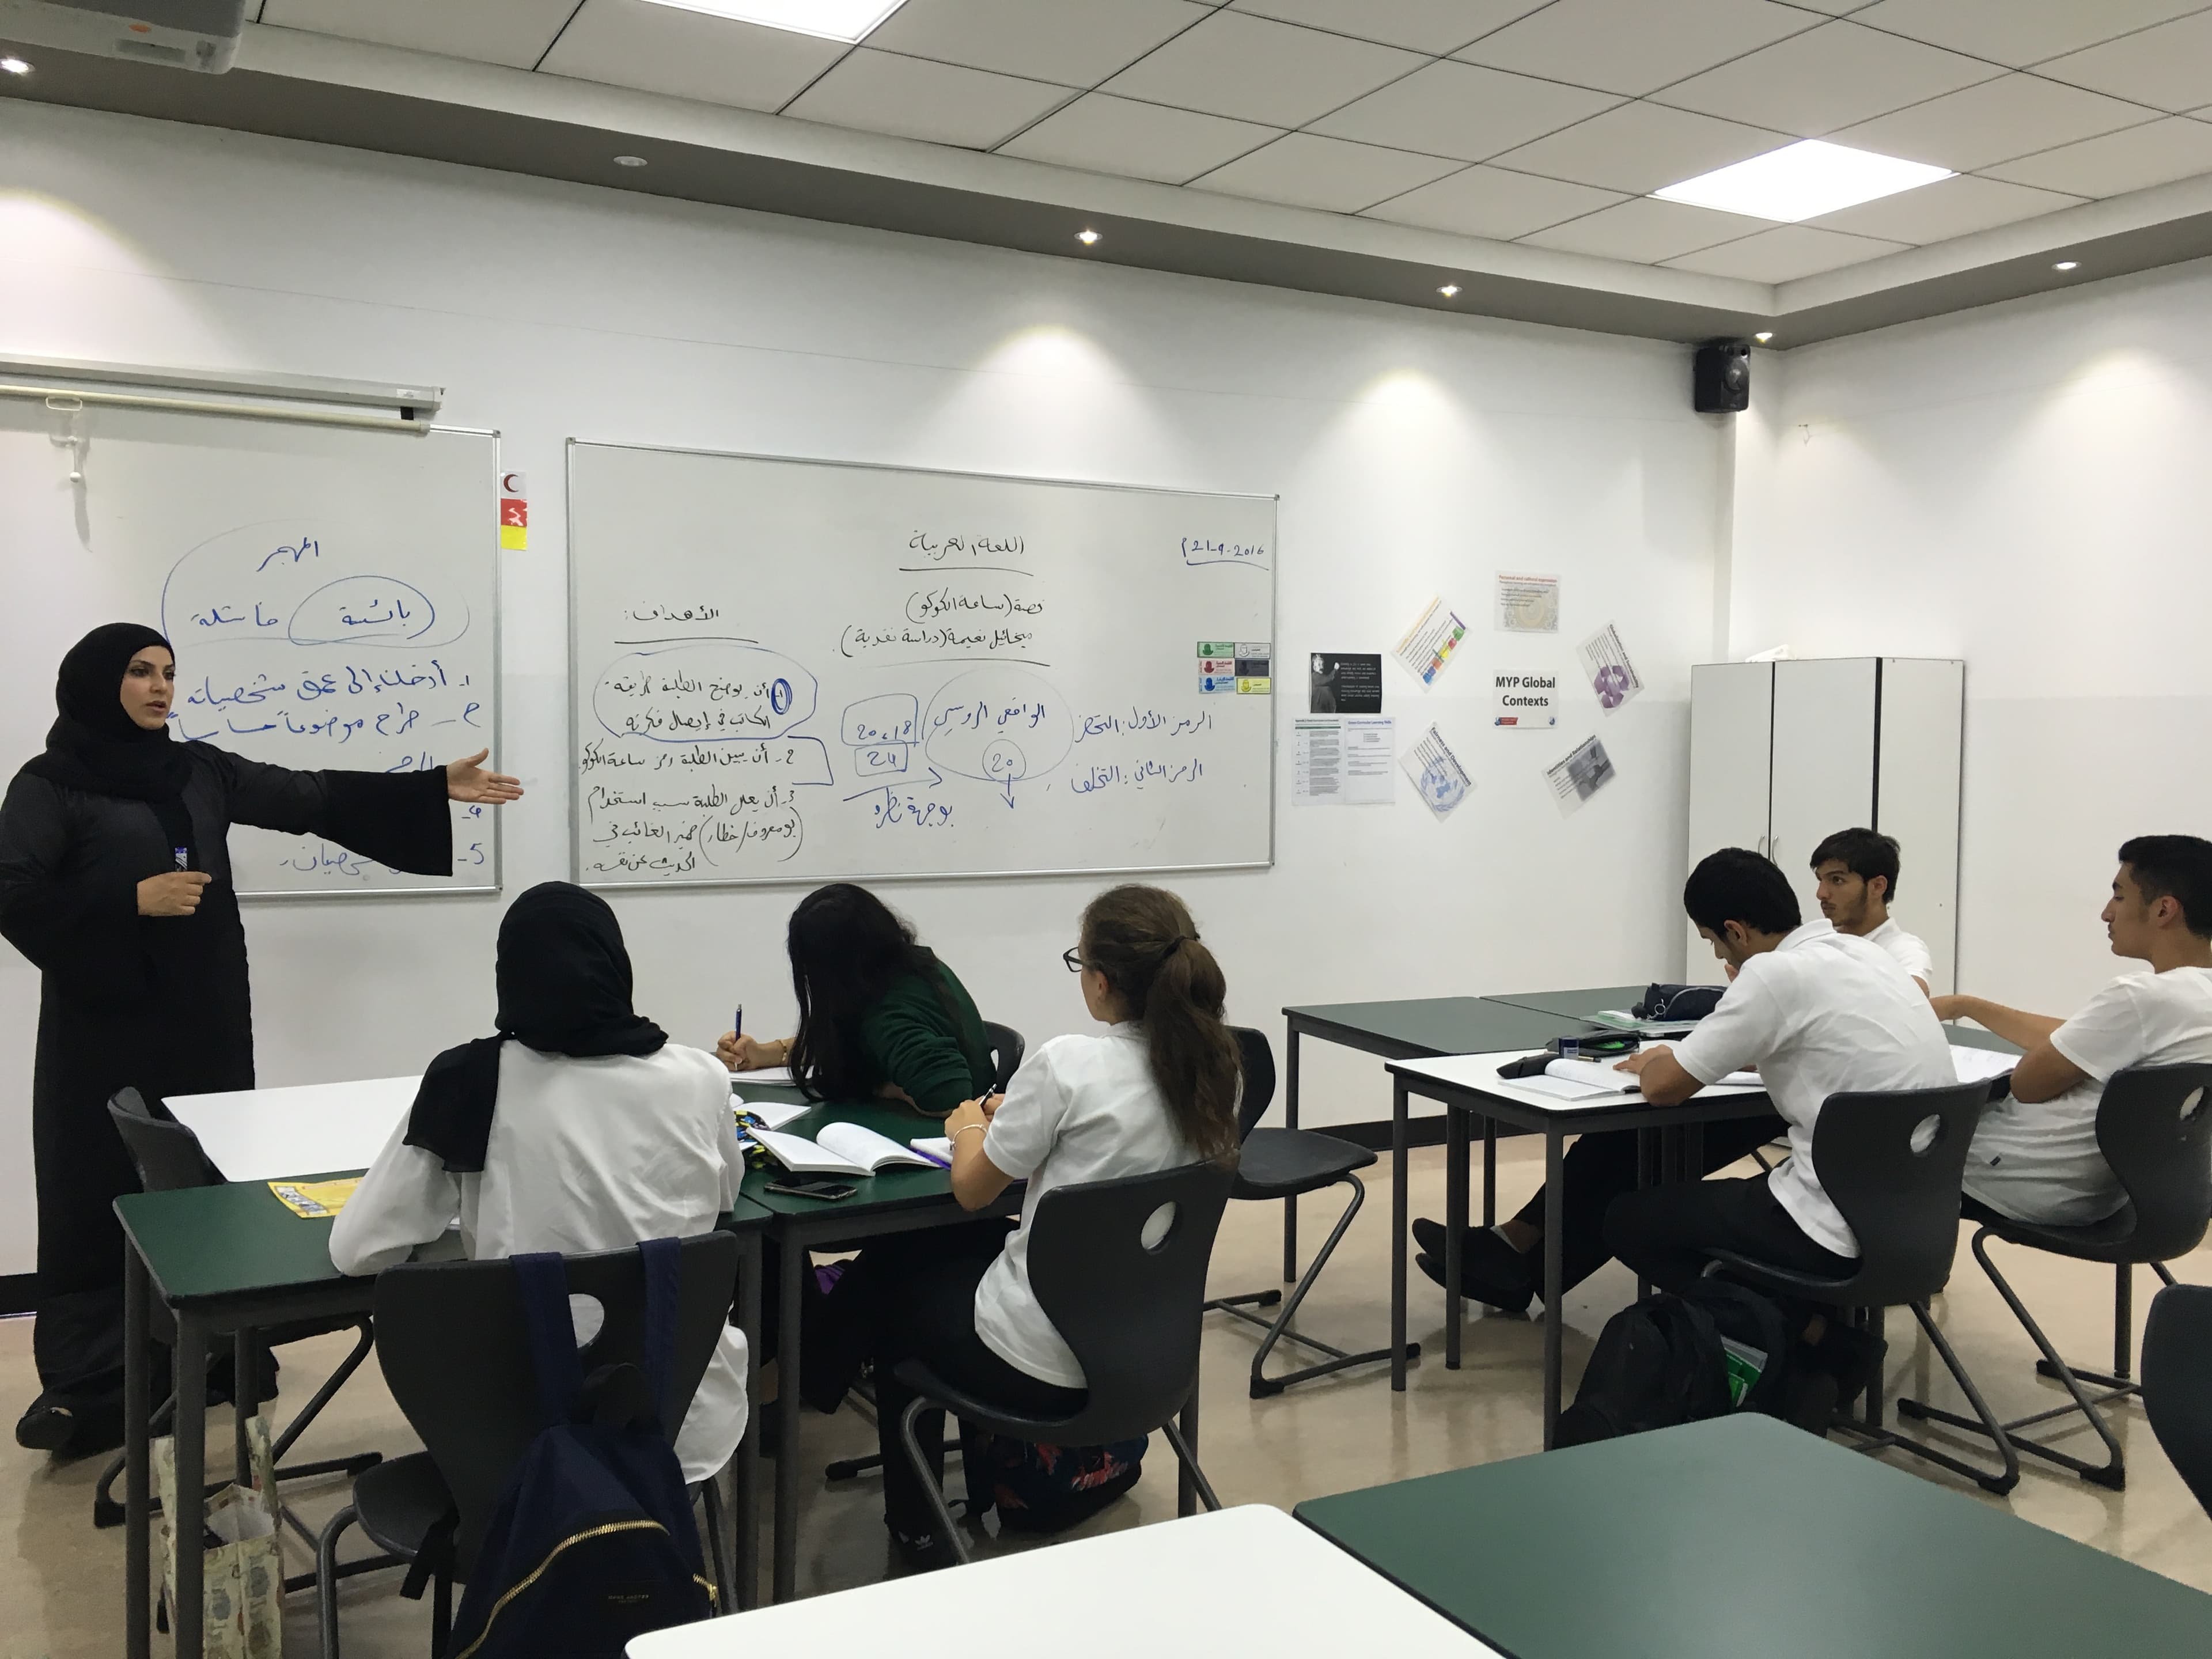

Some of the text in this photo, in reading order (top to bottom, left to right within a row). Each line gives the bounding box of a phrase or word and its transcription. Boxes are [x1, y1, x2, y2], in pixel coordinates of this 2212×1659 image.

[1495, 676, 1555, 688] MYP Global
[1502, 695, 1549, 706] Contexts
